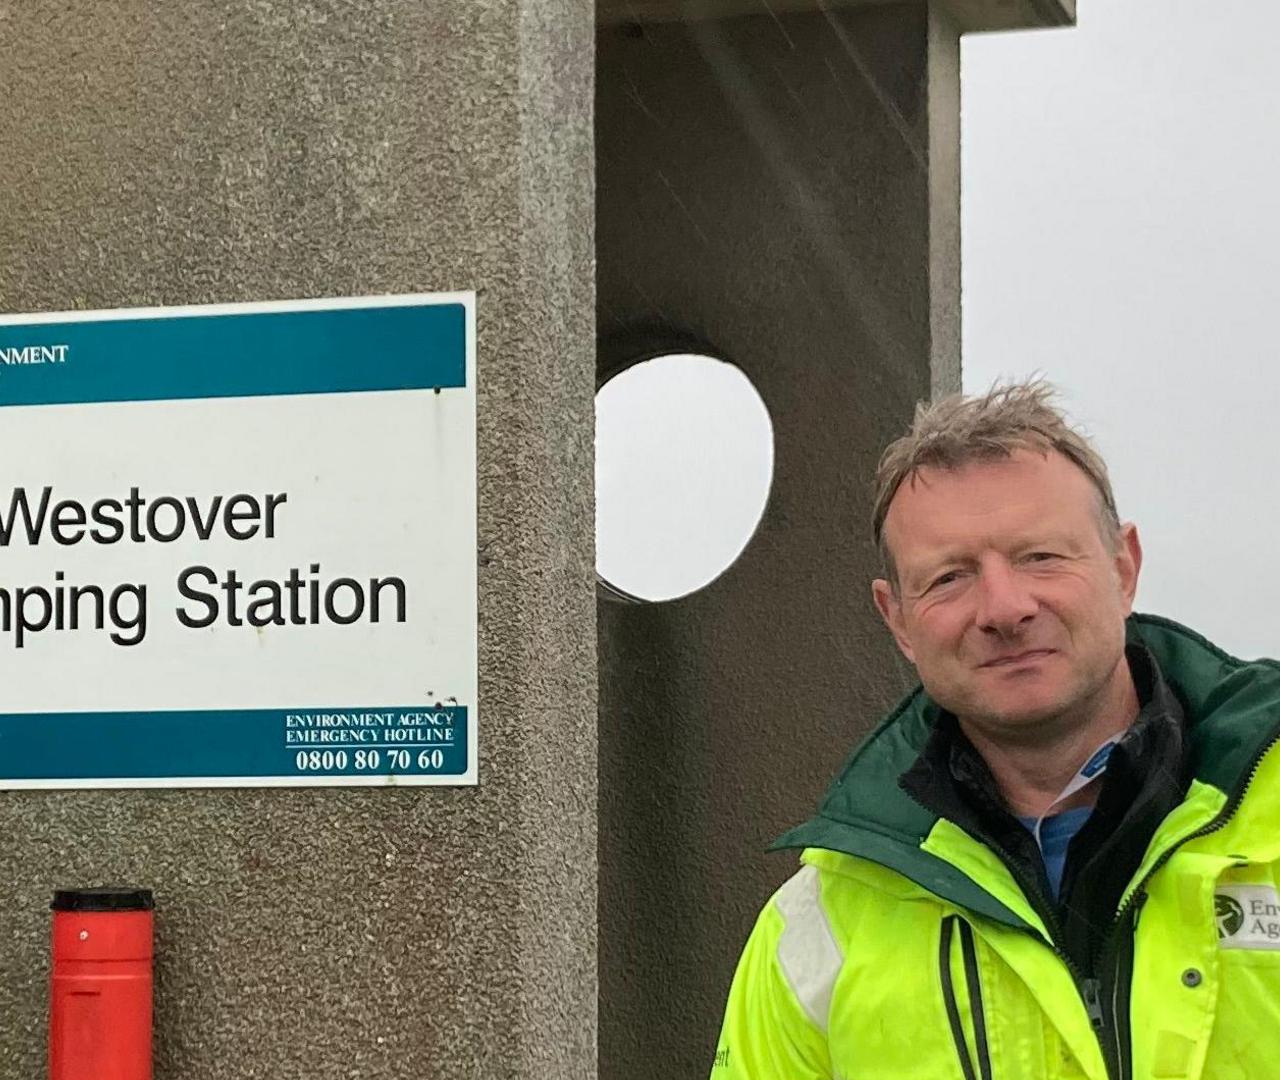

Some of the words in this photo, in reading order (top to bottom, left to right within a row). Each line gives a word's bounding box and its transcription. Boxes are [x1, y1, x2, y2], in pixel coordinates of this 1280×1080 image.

[176, 563, 407, 629] Station
[286, 713, 395, 727] ENVIRONMENT
[397, 712, 454, 726] AGENCY
[286, 729, 380, 743] EMERGENCY
[384, 728, 454, 742] HOTLINE
[296, 750, 348, 770] 0800
[354, 749, 380, 769] 80
[387, 749, 411, 769] 70
[417, 749, 444, 768] 60
